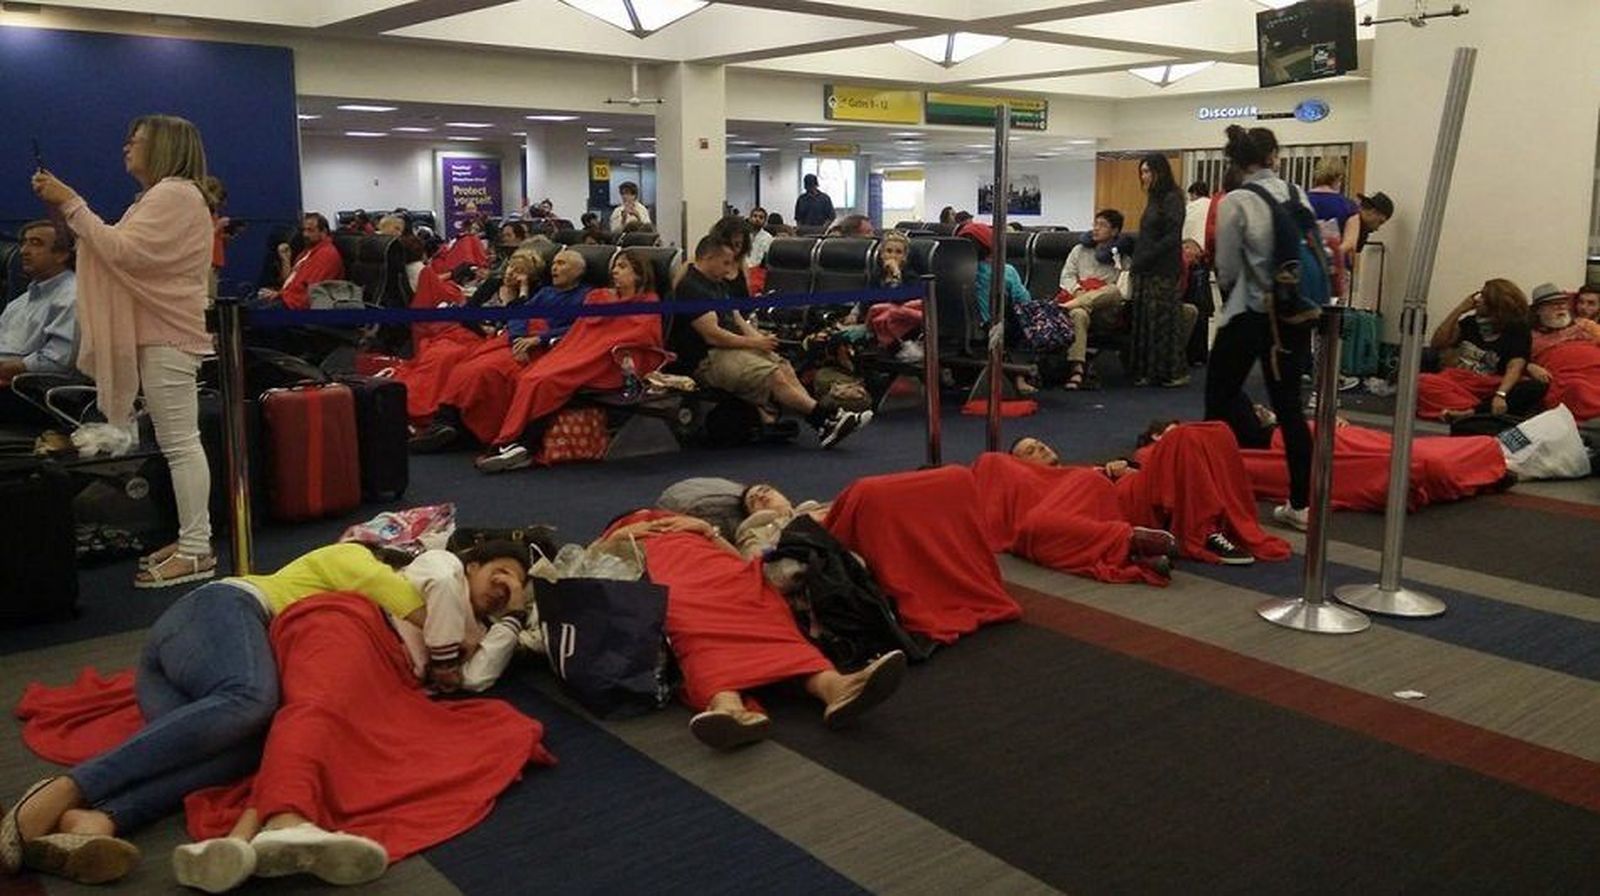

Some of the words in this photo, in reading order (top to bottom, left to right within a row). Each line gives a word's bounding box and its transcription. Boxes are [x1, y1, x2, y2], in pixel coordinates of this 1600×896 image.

[1199, 107, 1258, 119] DISCOVER
[595, 166, 608, 177] 10
[453, 185, 487, 195] Protect
